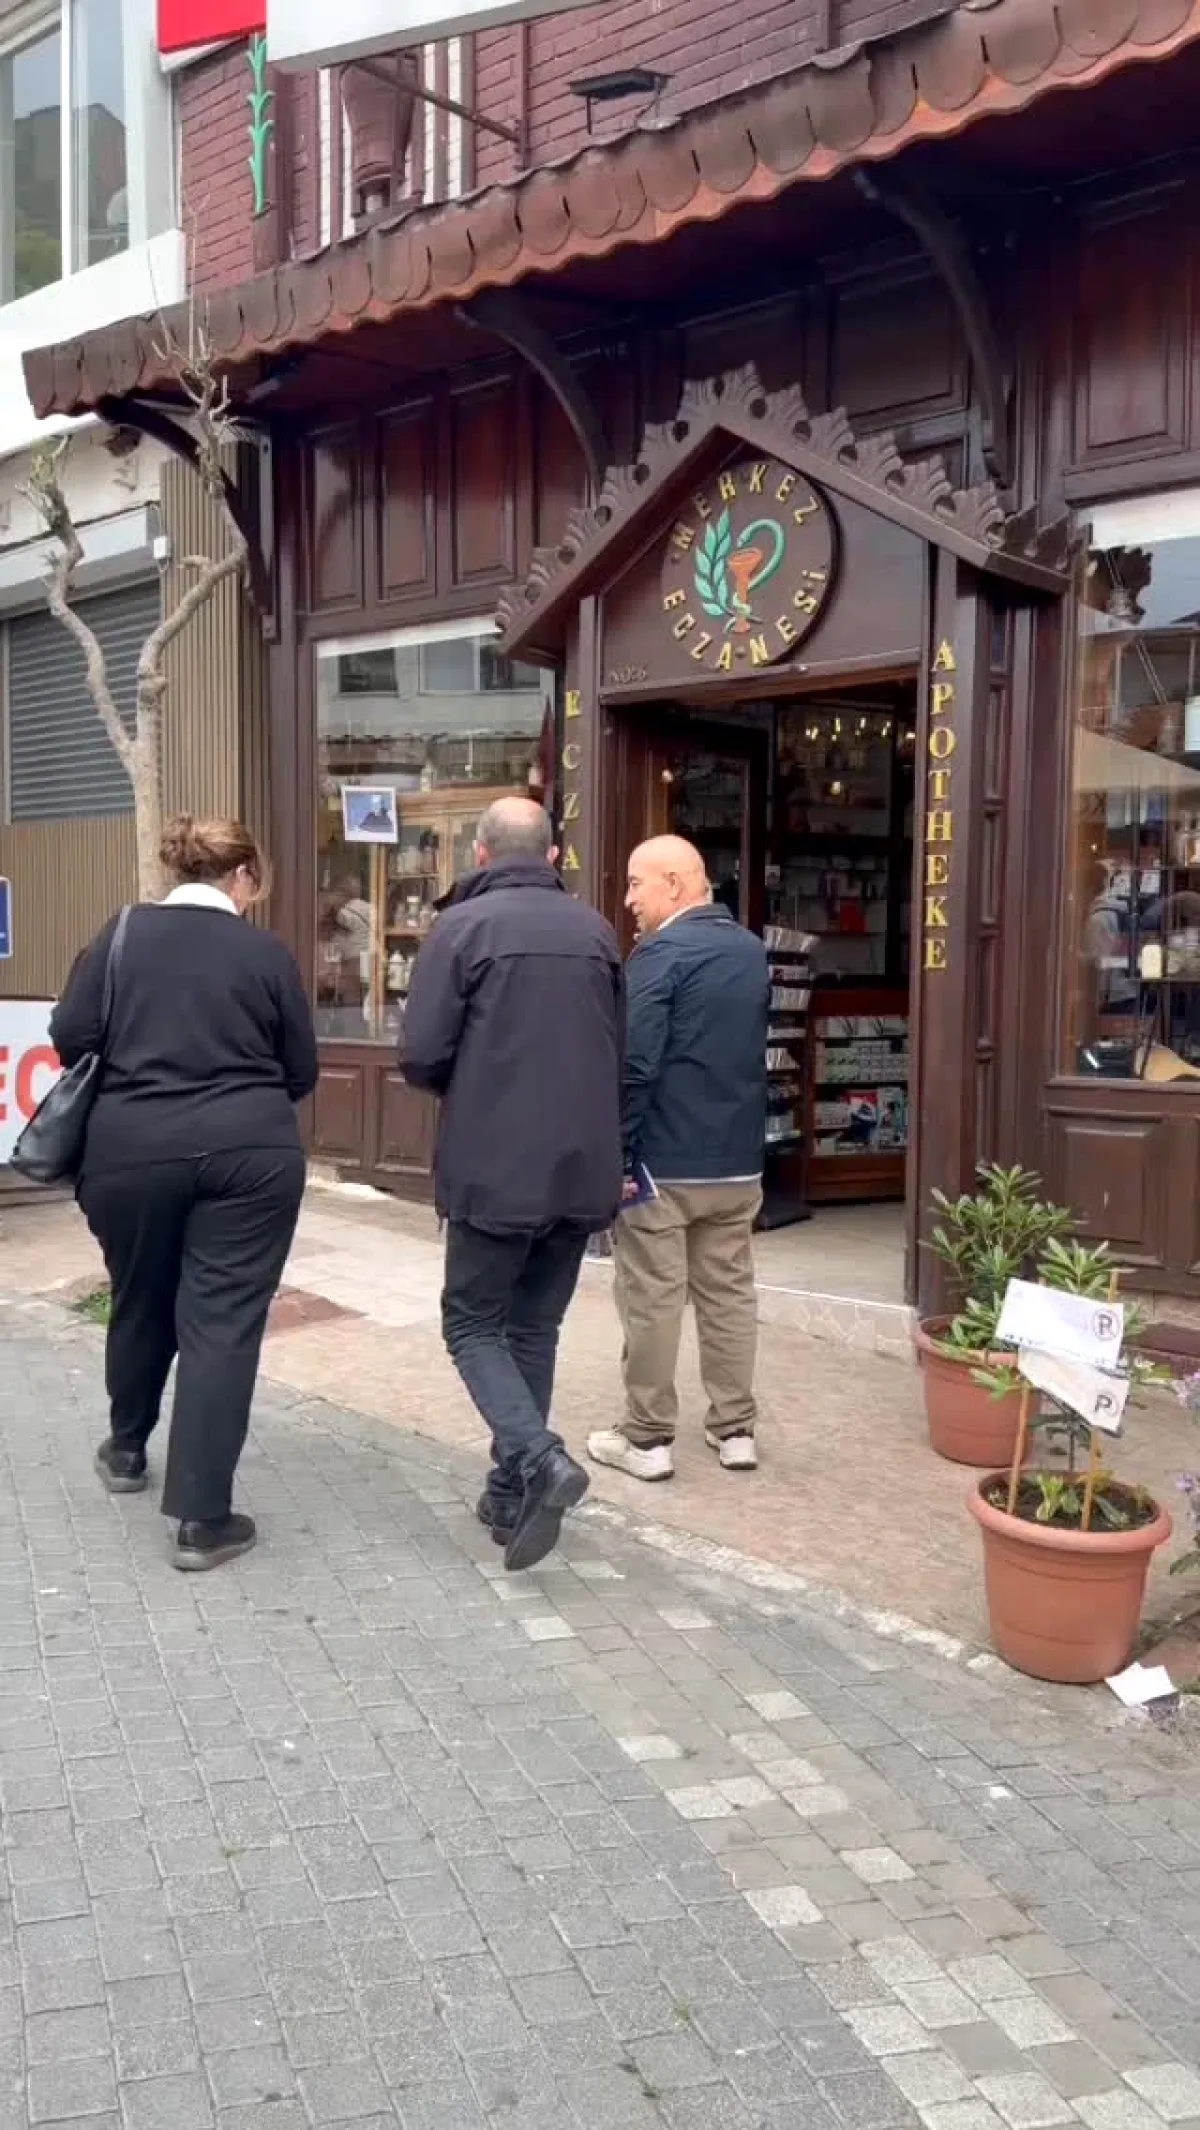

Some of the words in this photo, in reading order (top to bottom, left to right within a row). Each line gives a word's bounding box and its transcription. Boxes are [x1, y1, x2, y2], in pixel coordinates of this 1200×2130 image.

[672, 464, 822, 550] MERKEZ
[562, 689, 583, 898] ECZA
[923, 639, 958, 971] APOTHEKE
